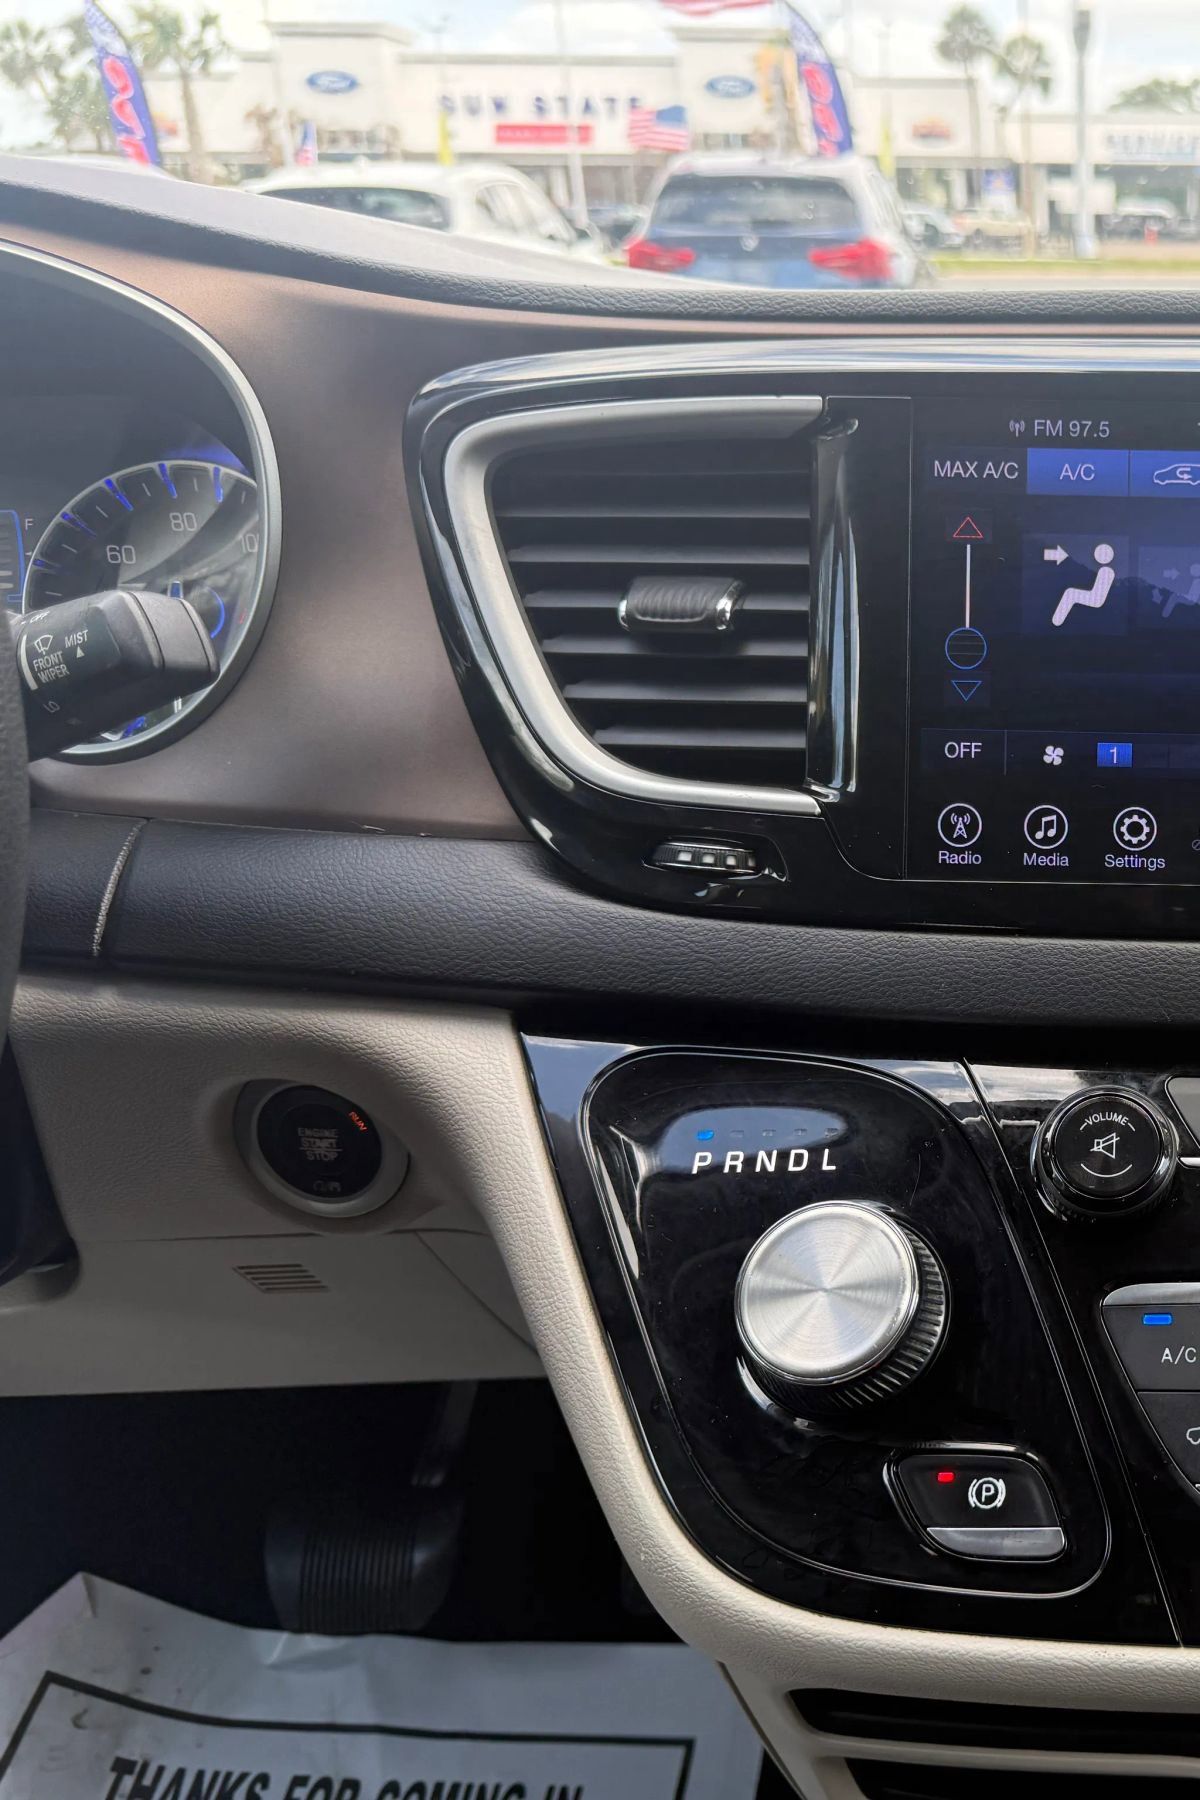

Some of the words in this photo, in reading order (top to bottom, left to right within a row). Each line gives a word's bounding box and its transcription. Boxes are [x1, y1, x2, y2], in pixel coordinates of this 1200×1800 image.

[1034, 420, 1063, 437] FM
[1069, 421, 1110, 438] 97.5
[934, 460, 978, 478] MAX
[983, 462, 1019, 479] A/C
[1059, 464, 1095, 481] A/C
[25, 518, 33, 531] F
[169, 512, 197, 532] 80
[241, 533, 260, 553] 10
[106, 545, 136, 564] 60
[64, 629, 88, 649] MIST
[33, 650, 63, 672] FRONT
[37, 663, 70, 684] WIPER
[944, 741, 982, 759] OFF
[1109, 746, 1119, 764] 1
[938, 850, 982, 865] Radio
[1023, 852, 1069, 867] Media
[1104, 854, 1166, 871] Settings
[1085, 1111, 1130, 1127] VOLUME
[297, 1127, 339, 1138] ENGINE
[692, 1152, 712, 1175] P
[723, 1151, 744, 1174] R
[755, 1150, 777, 1173] N
[788, 1149, 808, 1172] D
[822, 1148, 837, 1171] L
[1161, 1345, 1198, 1365] A/C
